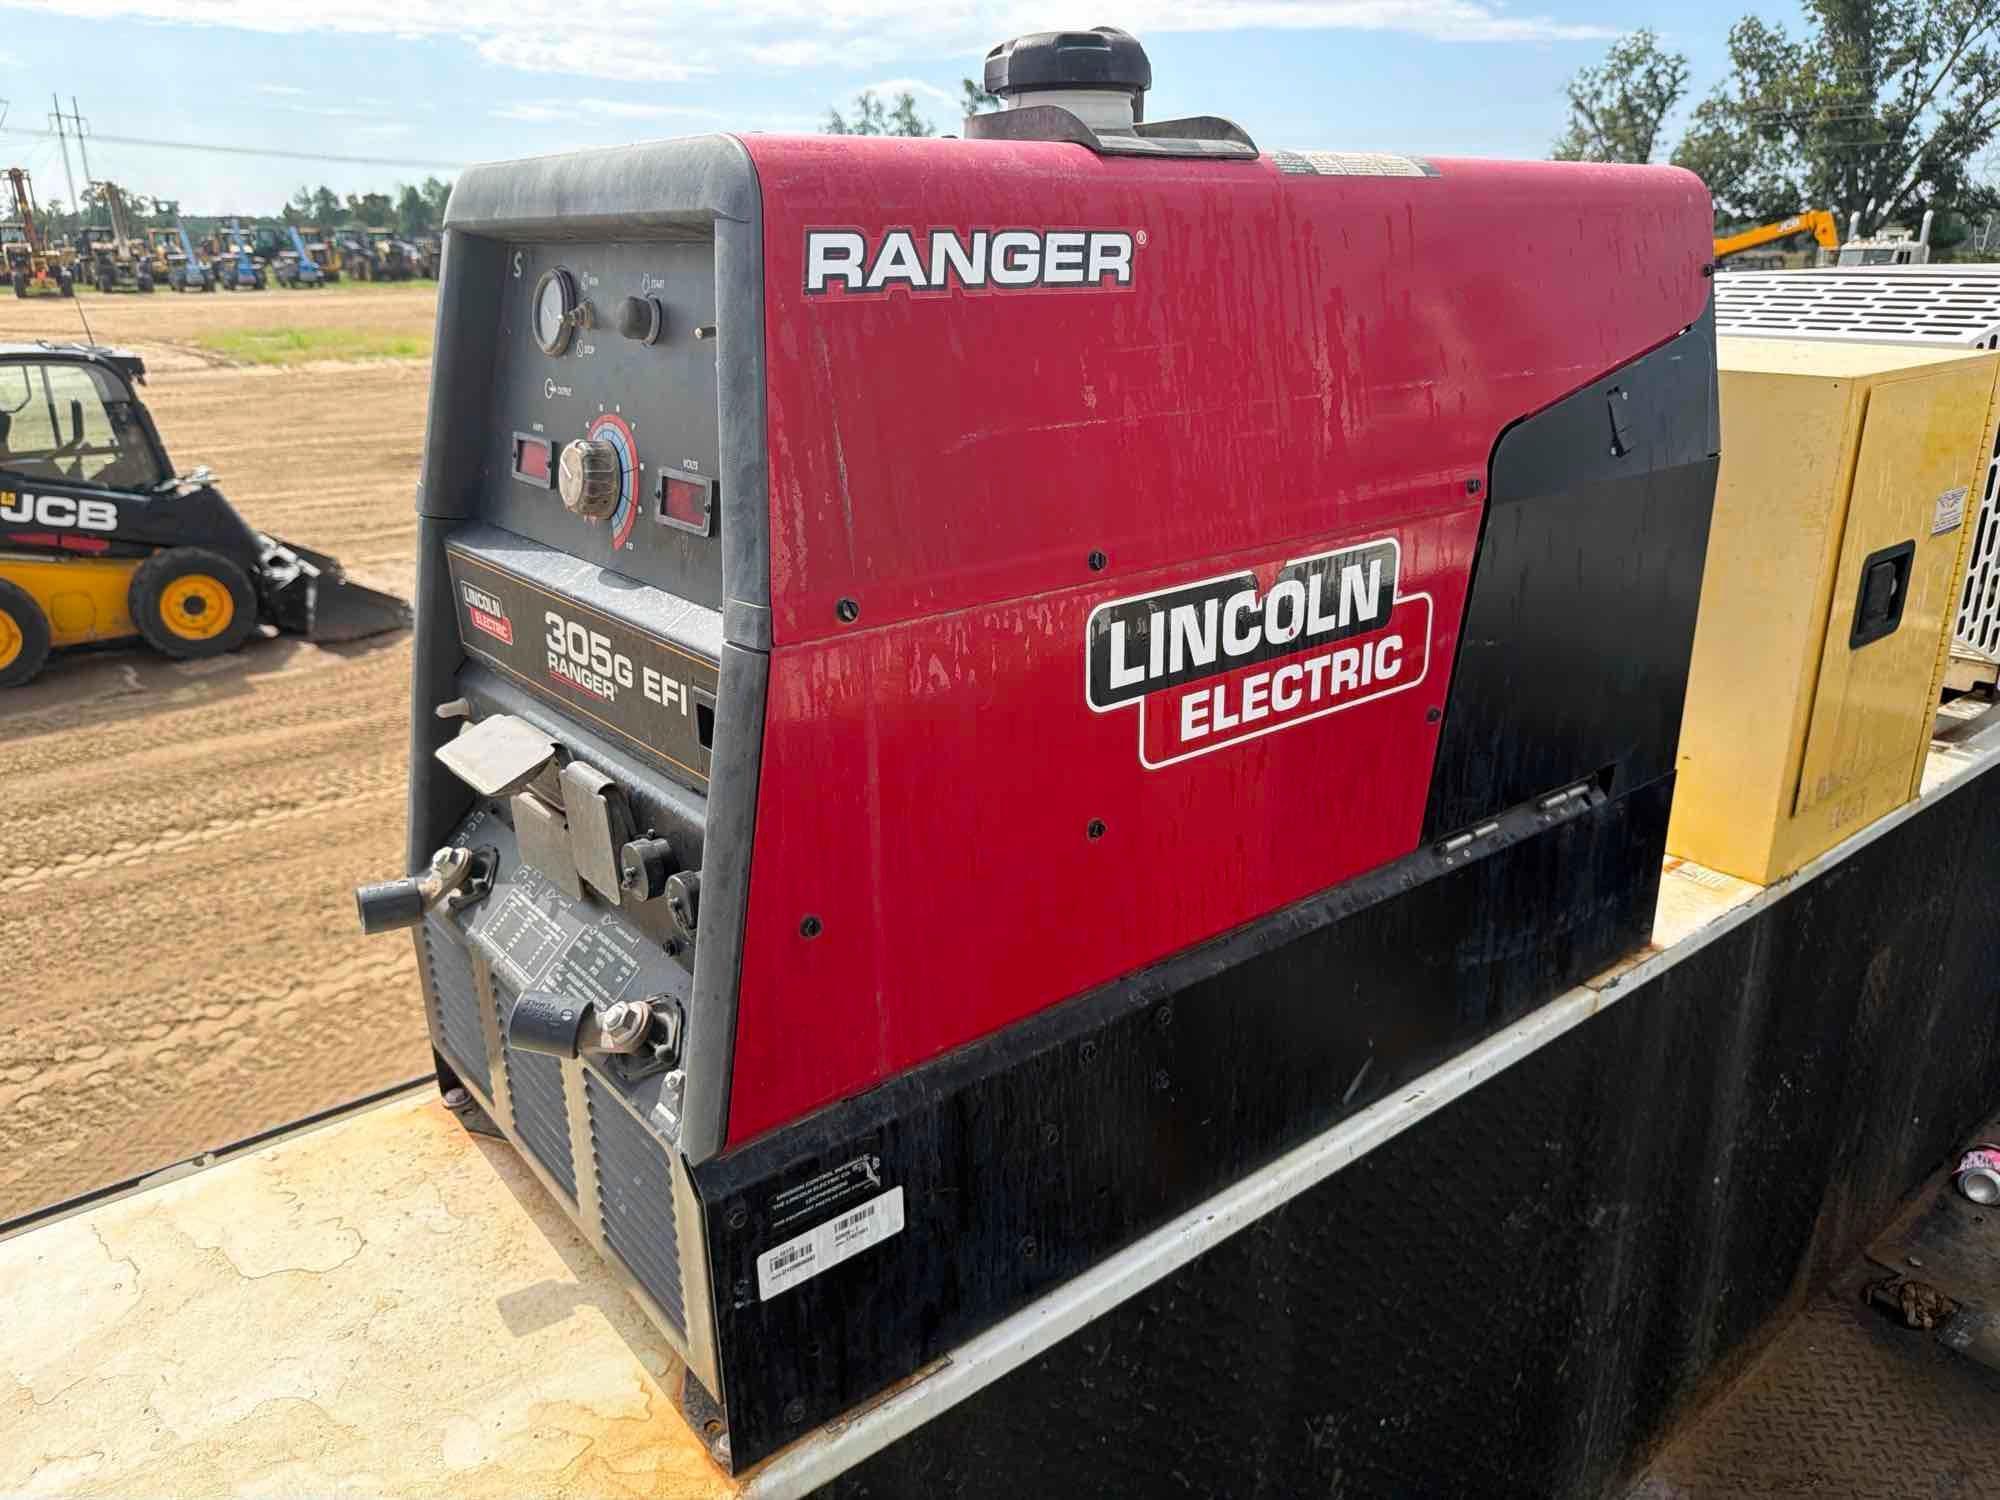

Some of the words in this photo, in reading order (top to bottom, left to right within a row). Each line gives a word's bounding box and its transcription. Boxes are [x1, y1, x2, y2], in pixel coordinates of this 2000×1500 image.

[0, 493, 118, 531] JCB
[463, 583, 502, 618] LINCOLN
[1109, 558, 1382, 691] LINCOLN
[545, 610, 634, 689] 305G
[643, 666, 688, 717] EFI
[1180, 634, 1404, 743] ELECTRIC
